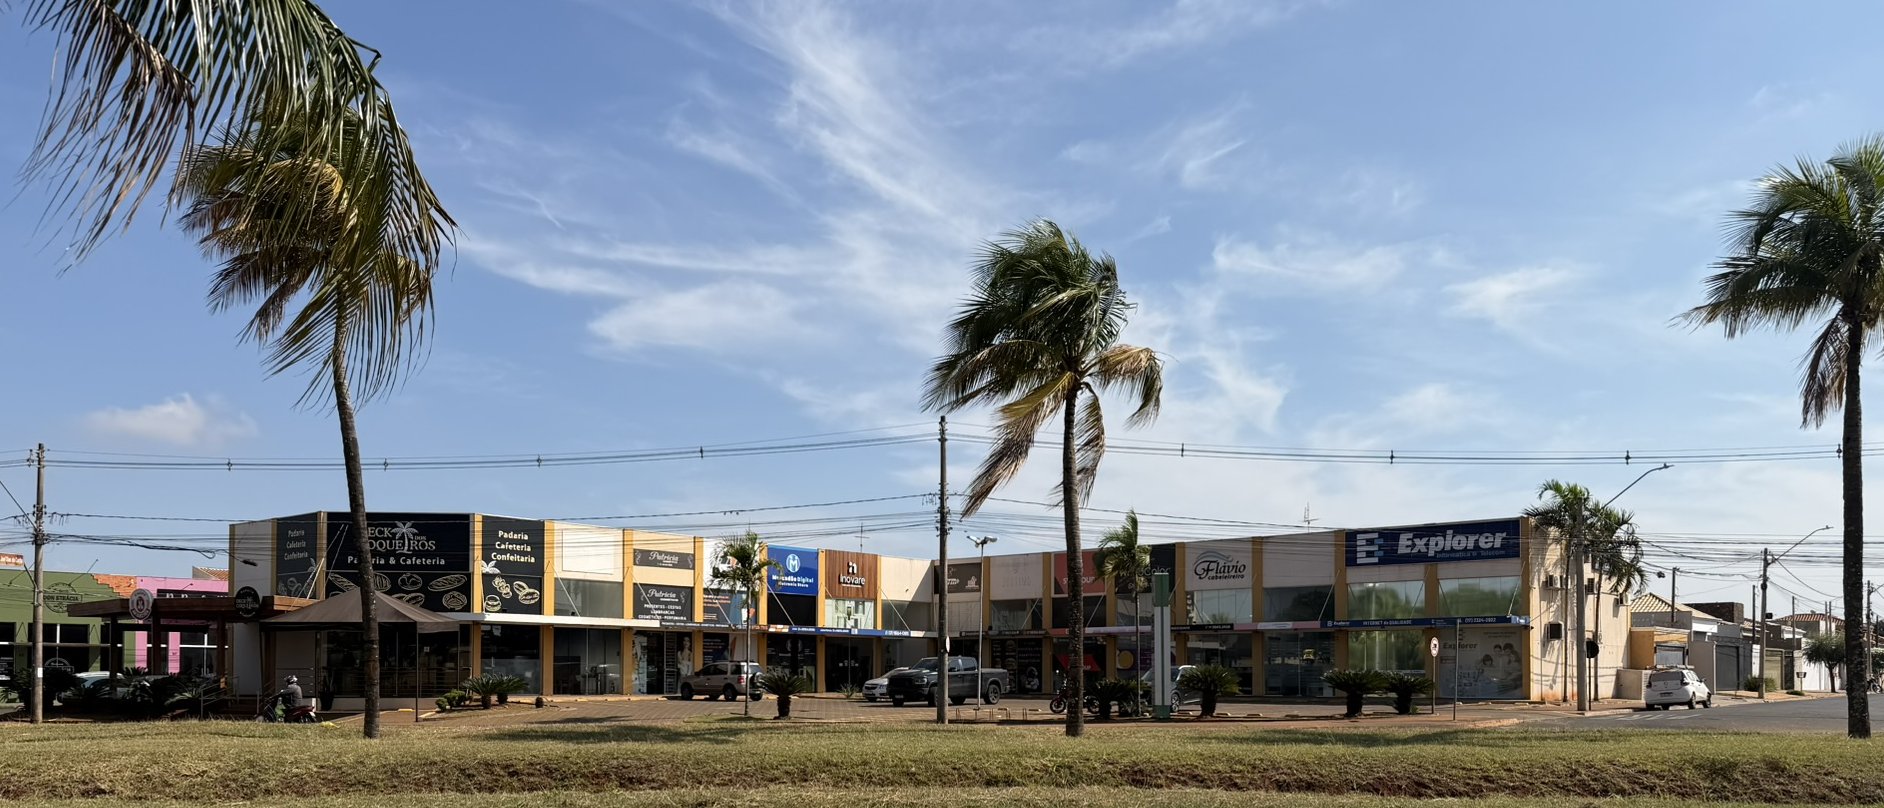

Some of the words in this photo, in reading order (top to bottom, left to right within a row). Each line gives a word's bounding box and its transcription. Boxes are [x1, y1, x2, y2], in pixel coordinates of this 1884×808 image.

[367, 526, 393, 538] ECK
[498, 530, 529, 540] Padaria
[367, 540, 436, 551] OQUEIROS
[495, 541, 532, 552] Cafeteria
[1397, 530, 1507, 557] Explorer
[348, 555, 386, 565] Paria
[389, 556, 396, 564] &
[399, 556, 446, 565] Cafeteria
[491, 552, 536, 563] Confeitaria
[1194, 560, 1247, 580] Flávio
